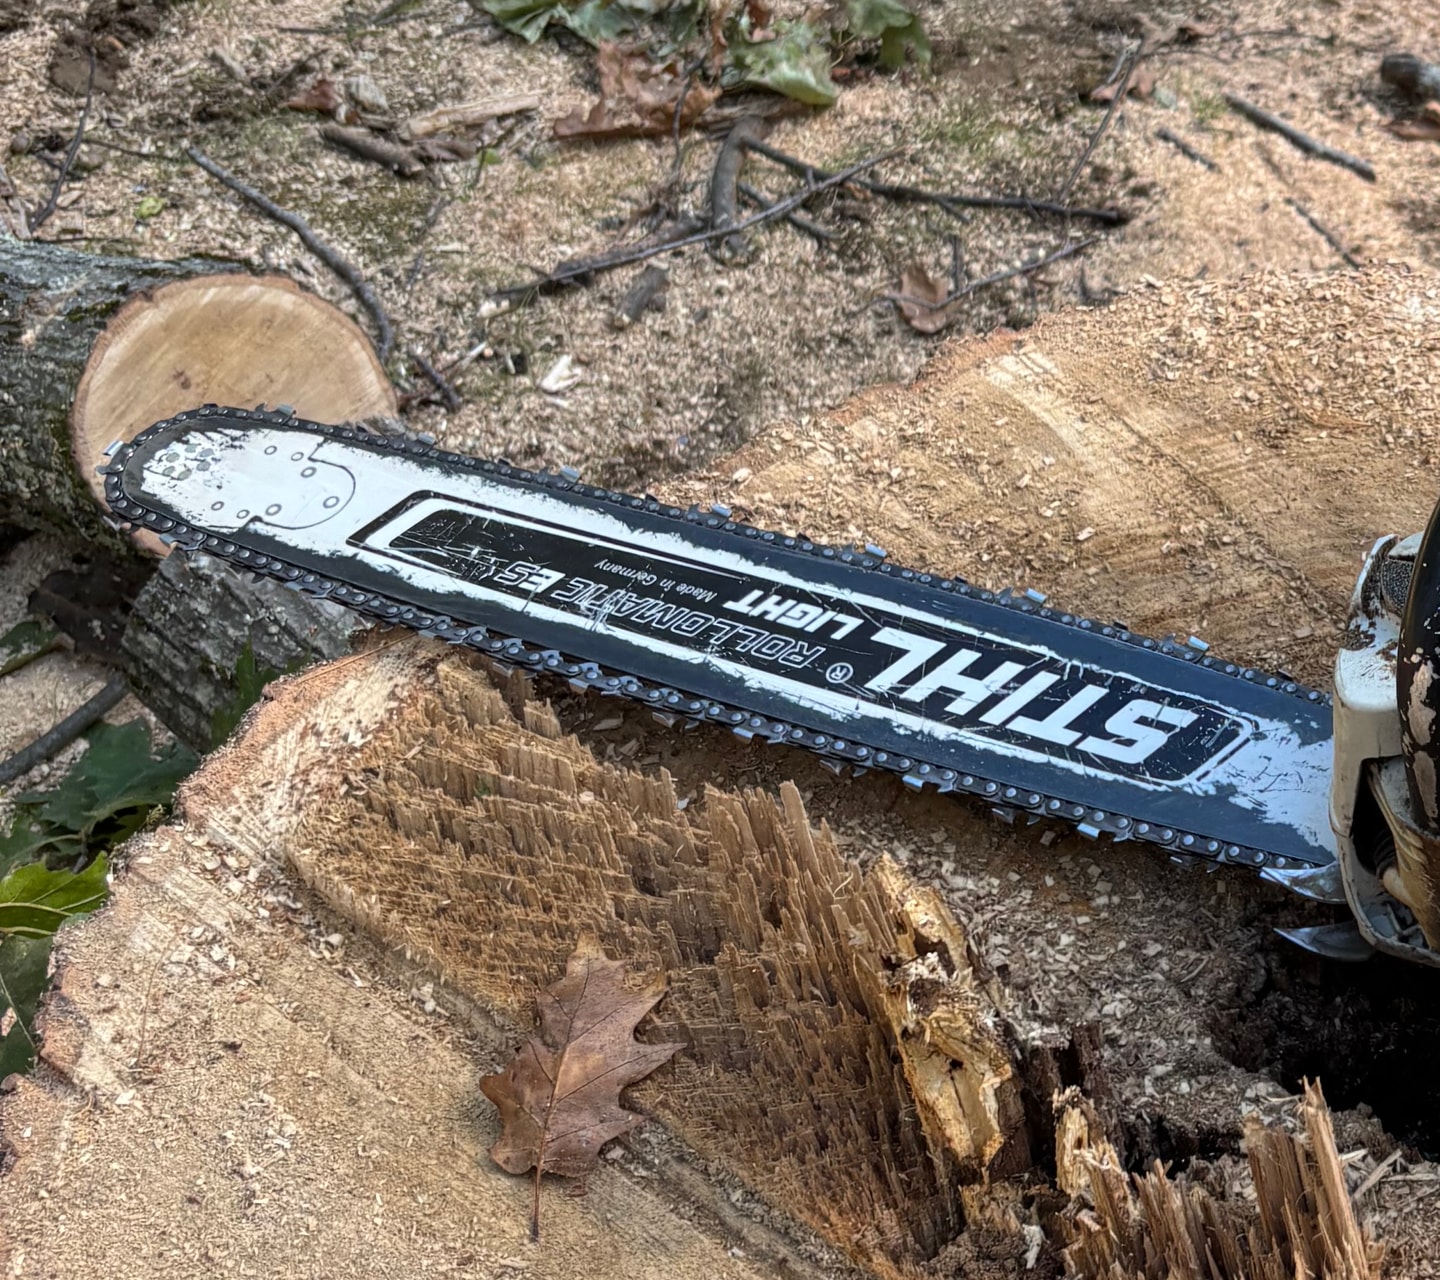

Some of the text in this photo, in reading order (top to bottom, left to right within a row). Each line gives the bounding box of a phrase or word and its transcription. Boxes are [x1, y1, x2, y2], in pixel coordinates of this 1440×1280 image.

[494, 561, 826, 669] ROLLOMATIC ES
[594, 559, 718, 603] Made in Germany
[723, 589, 864, 640] LIGHT
[864, 626, 1198, 764] STIHL
